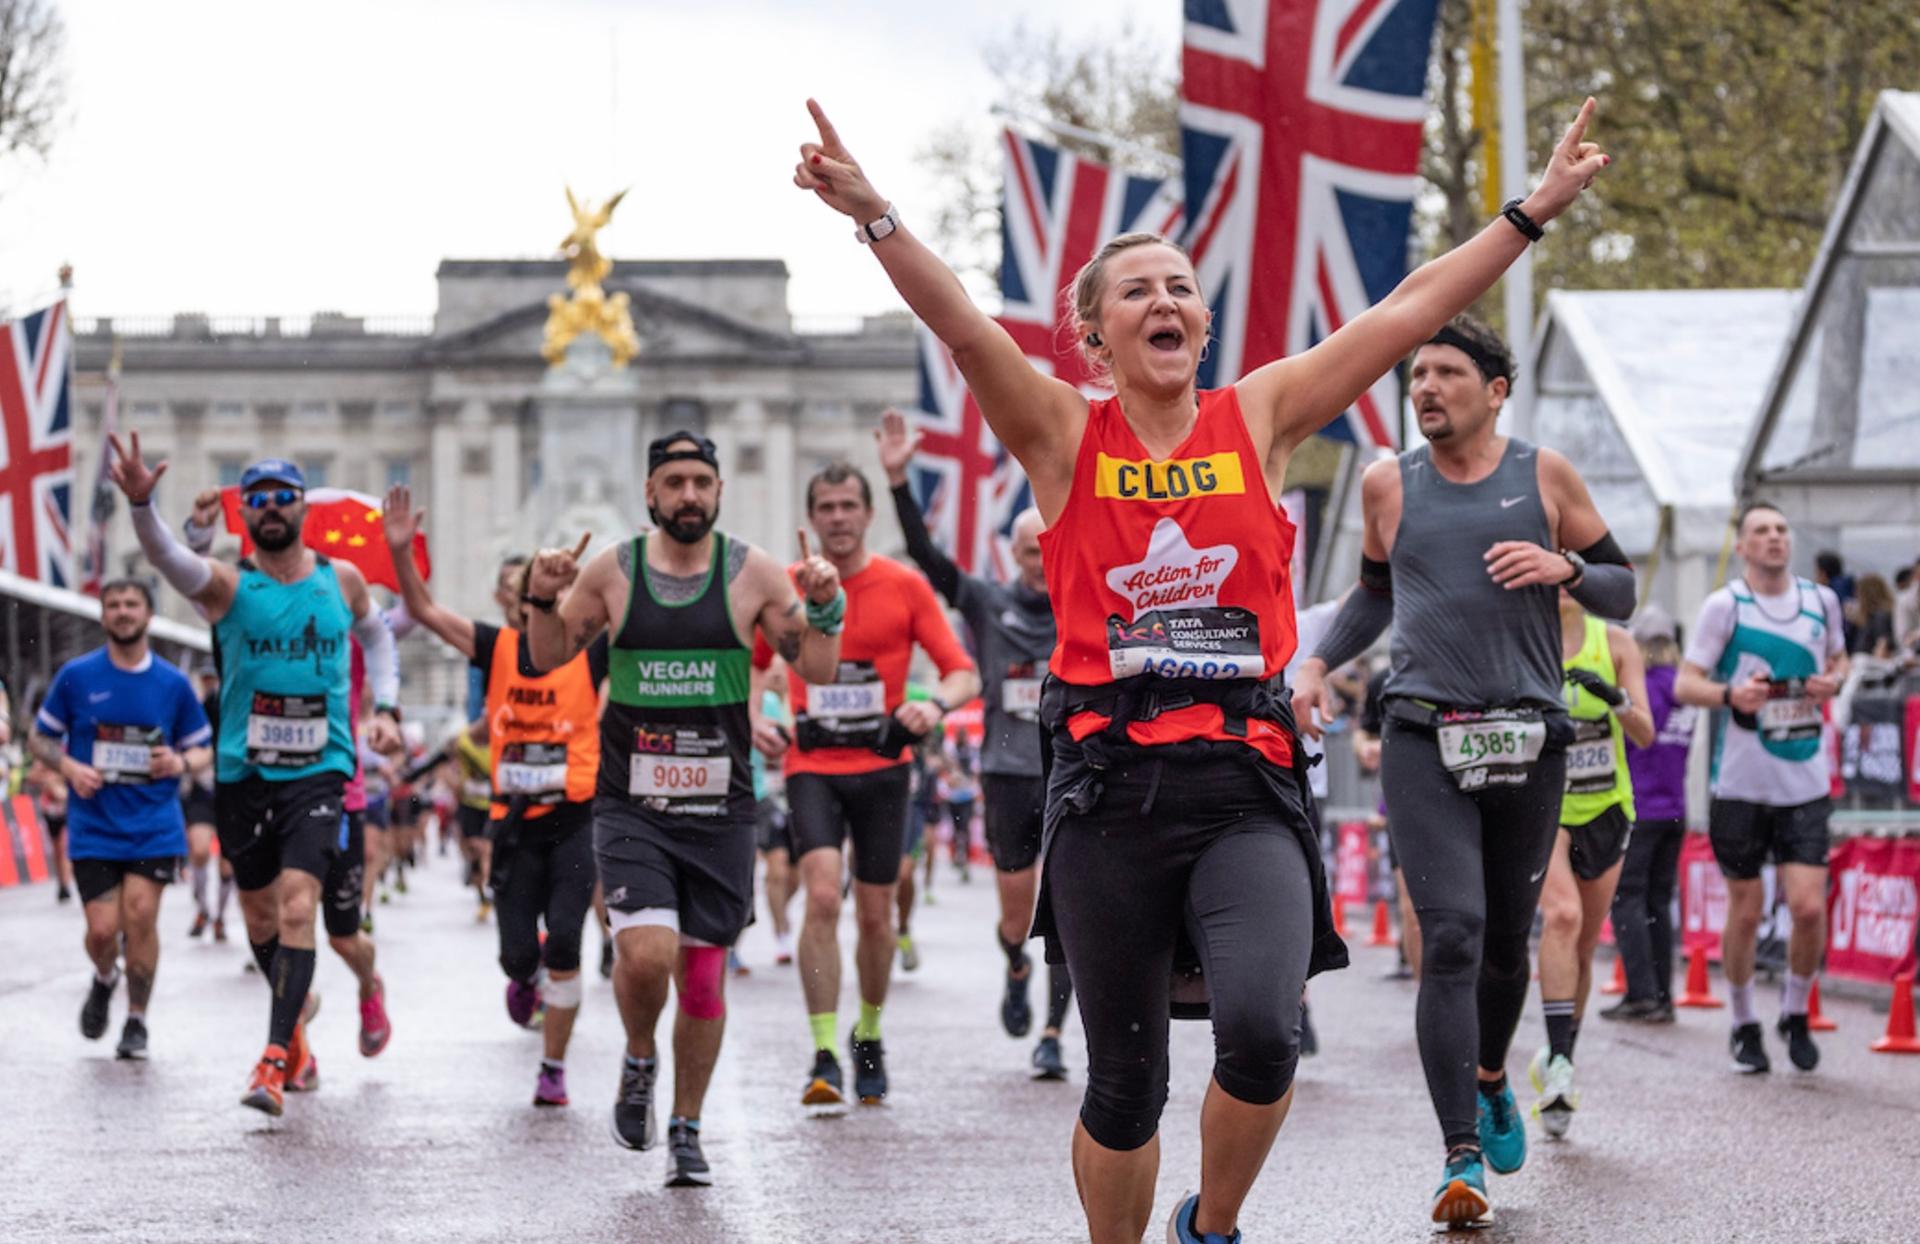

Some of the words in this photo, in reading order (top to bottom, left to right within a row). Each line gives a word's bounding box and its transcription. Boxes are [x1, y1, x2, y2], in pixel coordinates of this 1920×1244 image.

[1118, 461, 1217, 499] CLOG
[1123, 565, 1192, 592] Action
[1195, 556, 1225, 580] for
[1135, 583, 1215, 610] Children
[1168, 618, 1203, 629] TATA
[1170, 627, 1249, 640] CONSULTANCY
[1173, 640, 1222, 650] SERVICES
[638, 660, 716, 680] VEGAN
[639, 680, 715, 696] RUNNERS
[261, 724, 315, 745] 39811
[637, 728, 673, 752] tcs
[1459, 730, 1527, 757] 43851
[654, 764, 708, 789] 9030
